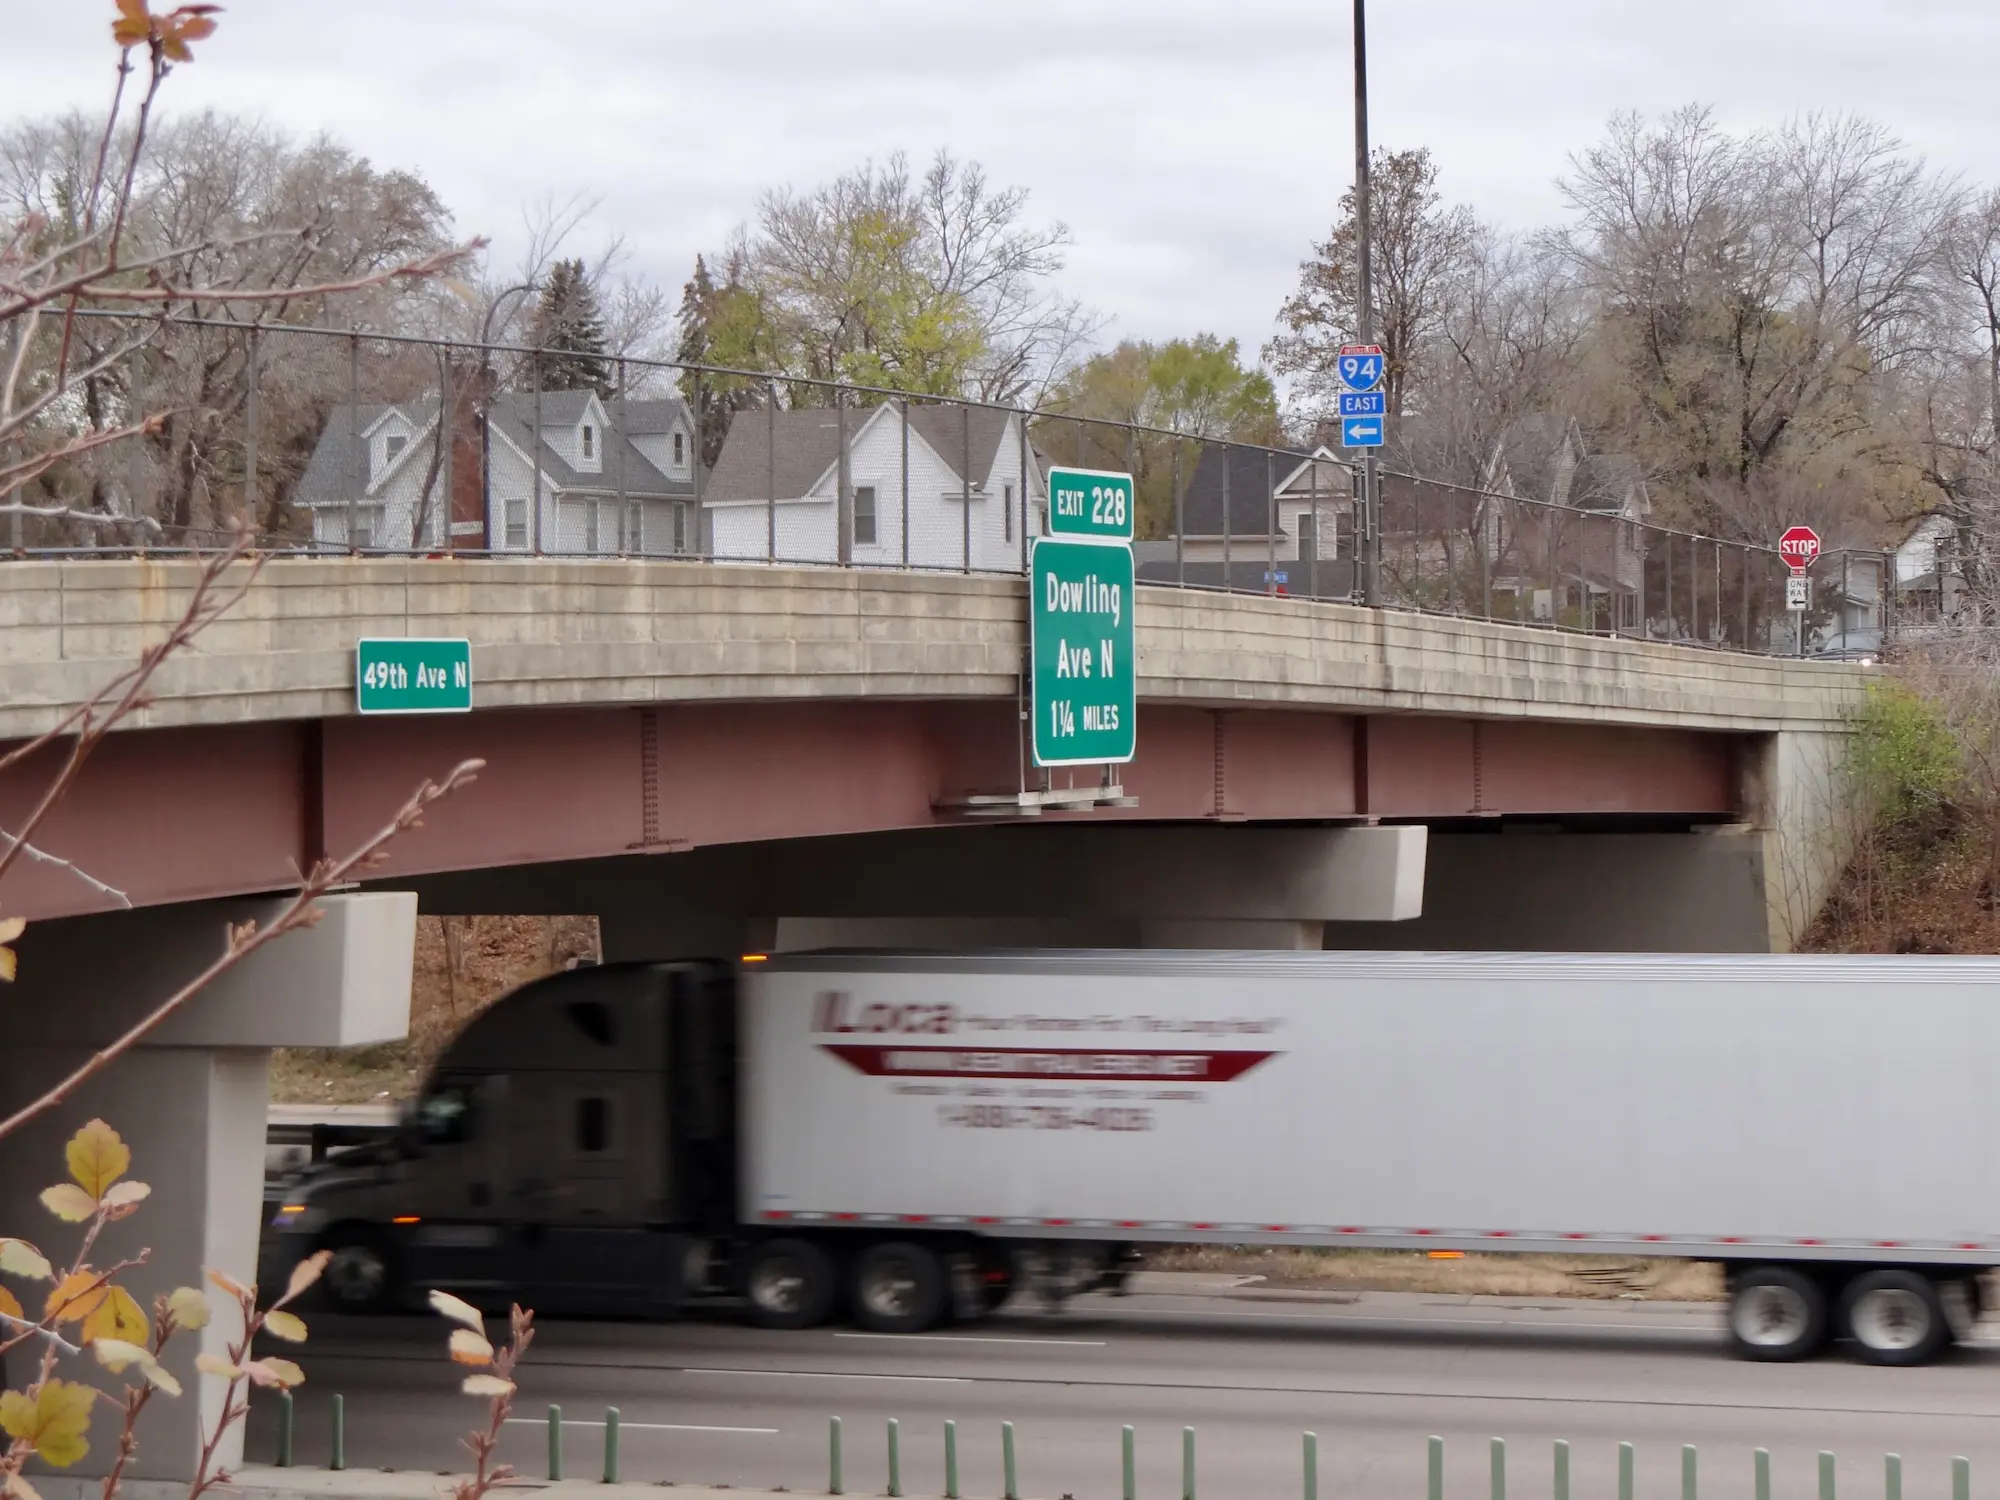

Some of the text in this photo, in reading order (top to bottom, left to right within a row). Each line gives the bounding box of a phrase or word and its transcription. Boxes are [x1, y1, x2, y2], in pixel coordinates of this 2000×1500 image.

[1344, 358, 1376, 380] 94
[1346, 396, 1378, 411] EAST
[1057, 486, 1126, 526] EXIT 228
[1782, 540, 1817, 555] STOP
[1046, 572, 1120, 628] Dowling
[1057, 639, 1113, 678] Ave N
[364, 661, 467, 689] 49th Ave N
[1083, 705, 1119, 731] MILES
